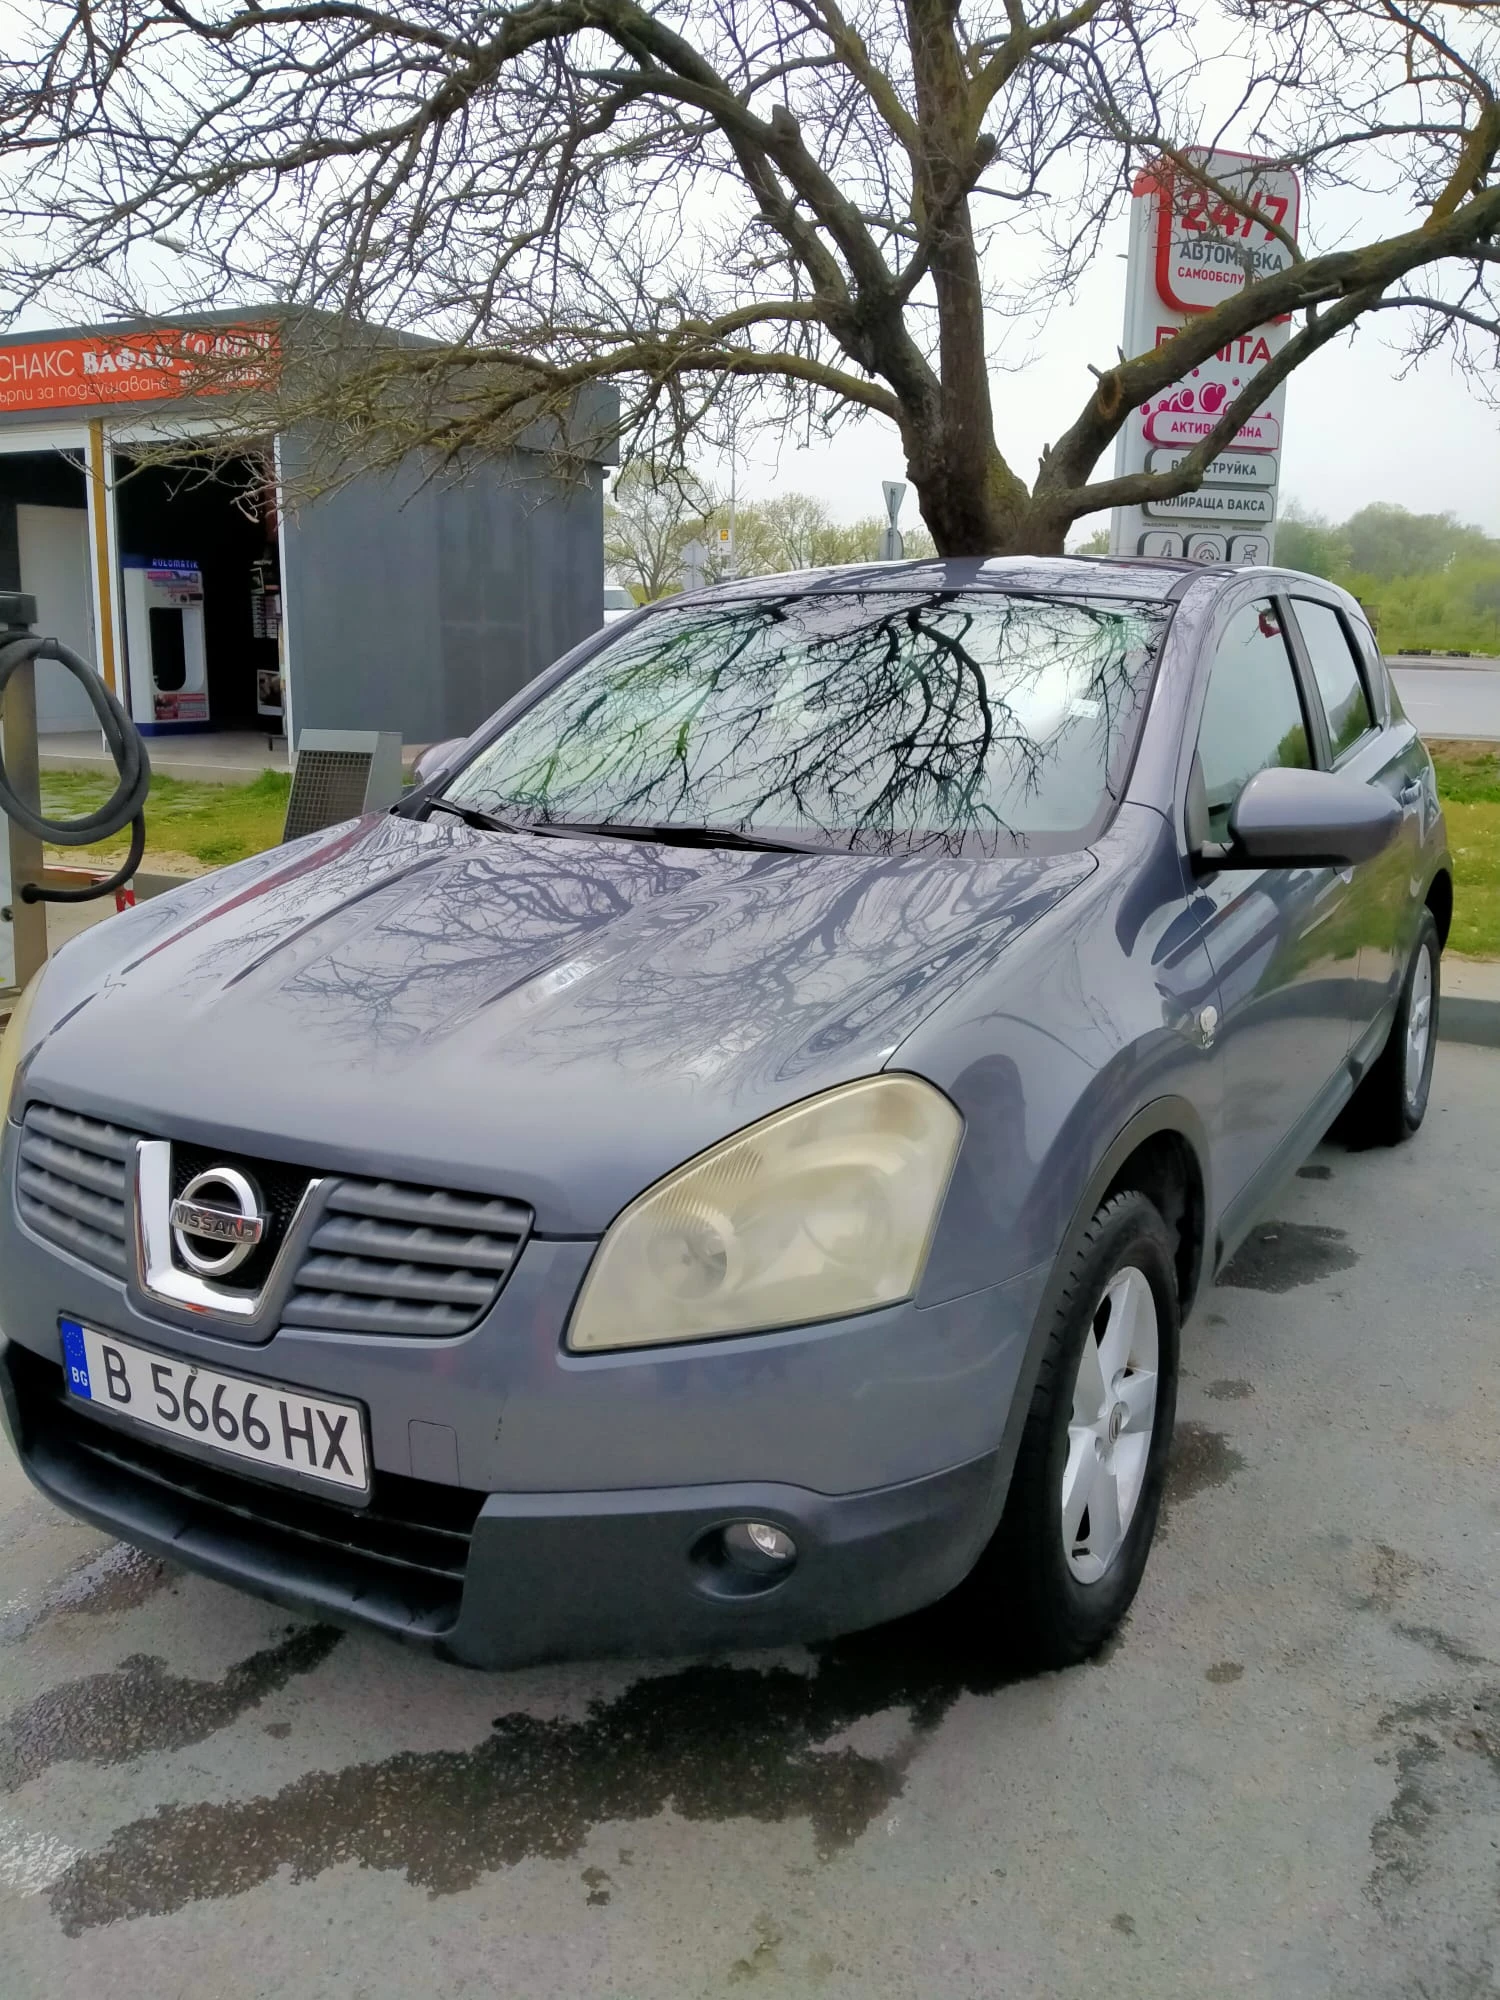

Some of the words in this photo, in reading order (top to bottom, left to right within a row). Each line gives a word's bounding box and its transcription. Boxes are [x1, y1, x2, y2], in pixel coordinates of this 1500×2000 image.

[1181, 187, 1289, 242] 24/7
[1180, 242, 1284, 272] АВТОМВКА
[1177, 266, 1261, 285] САМООБСЛУ
[37, 387, 54, 400] за
[1170, 421, 1216, 435] АКТИВ
[1237, 426, 1263, 438] ЯНА
[1171, 460, 1257, 476] ВСТРУЙКА
[1227, 498, 1265, 512] ВАКСА
[172, 1202, 245, 1239] NISSAN
[71, 1366, 89, 1387] BG
[101, 1345, 132, 1404] B
[150, 1362, 271, 1451] 5666
[278, 1400, 354, 1477] HX
